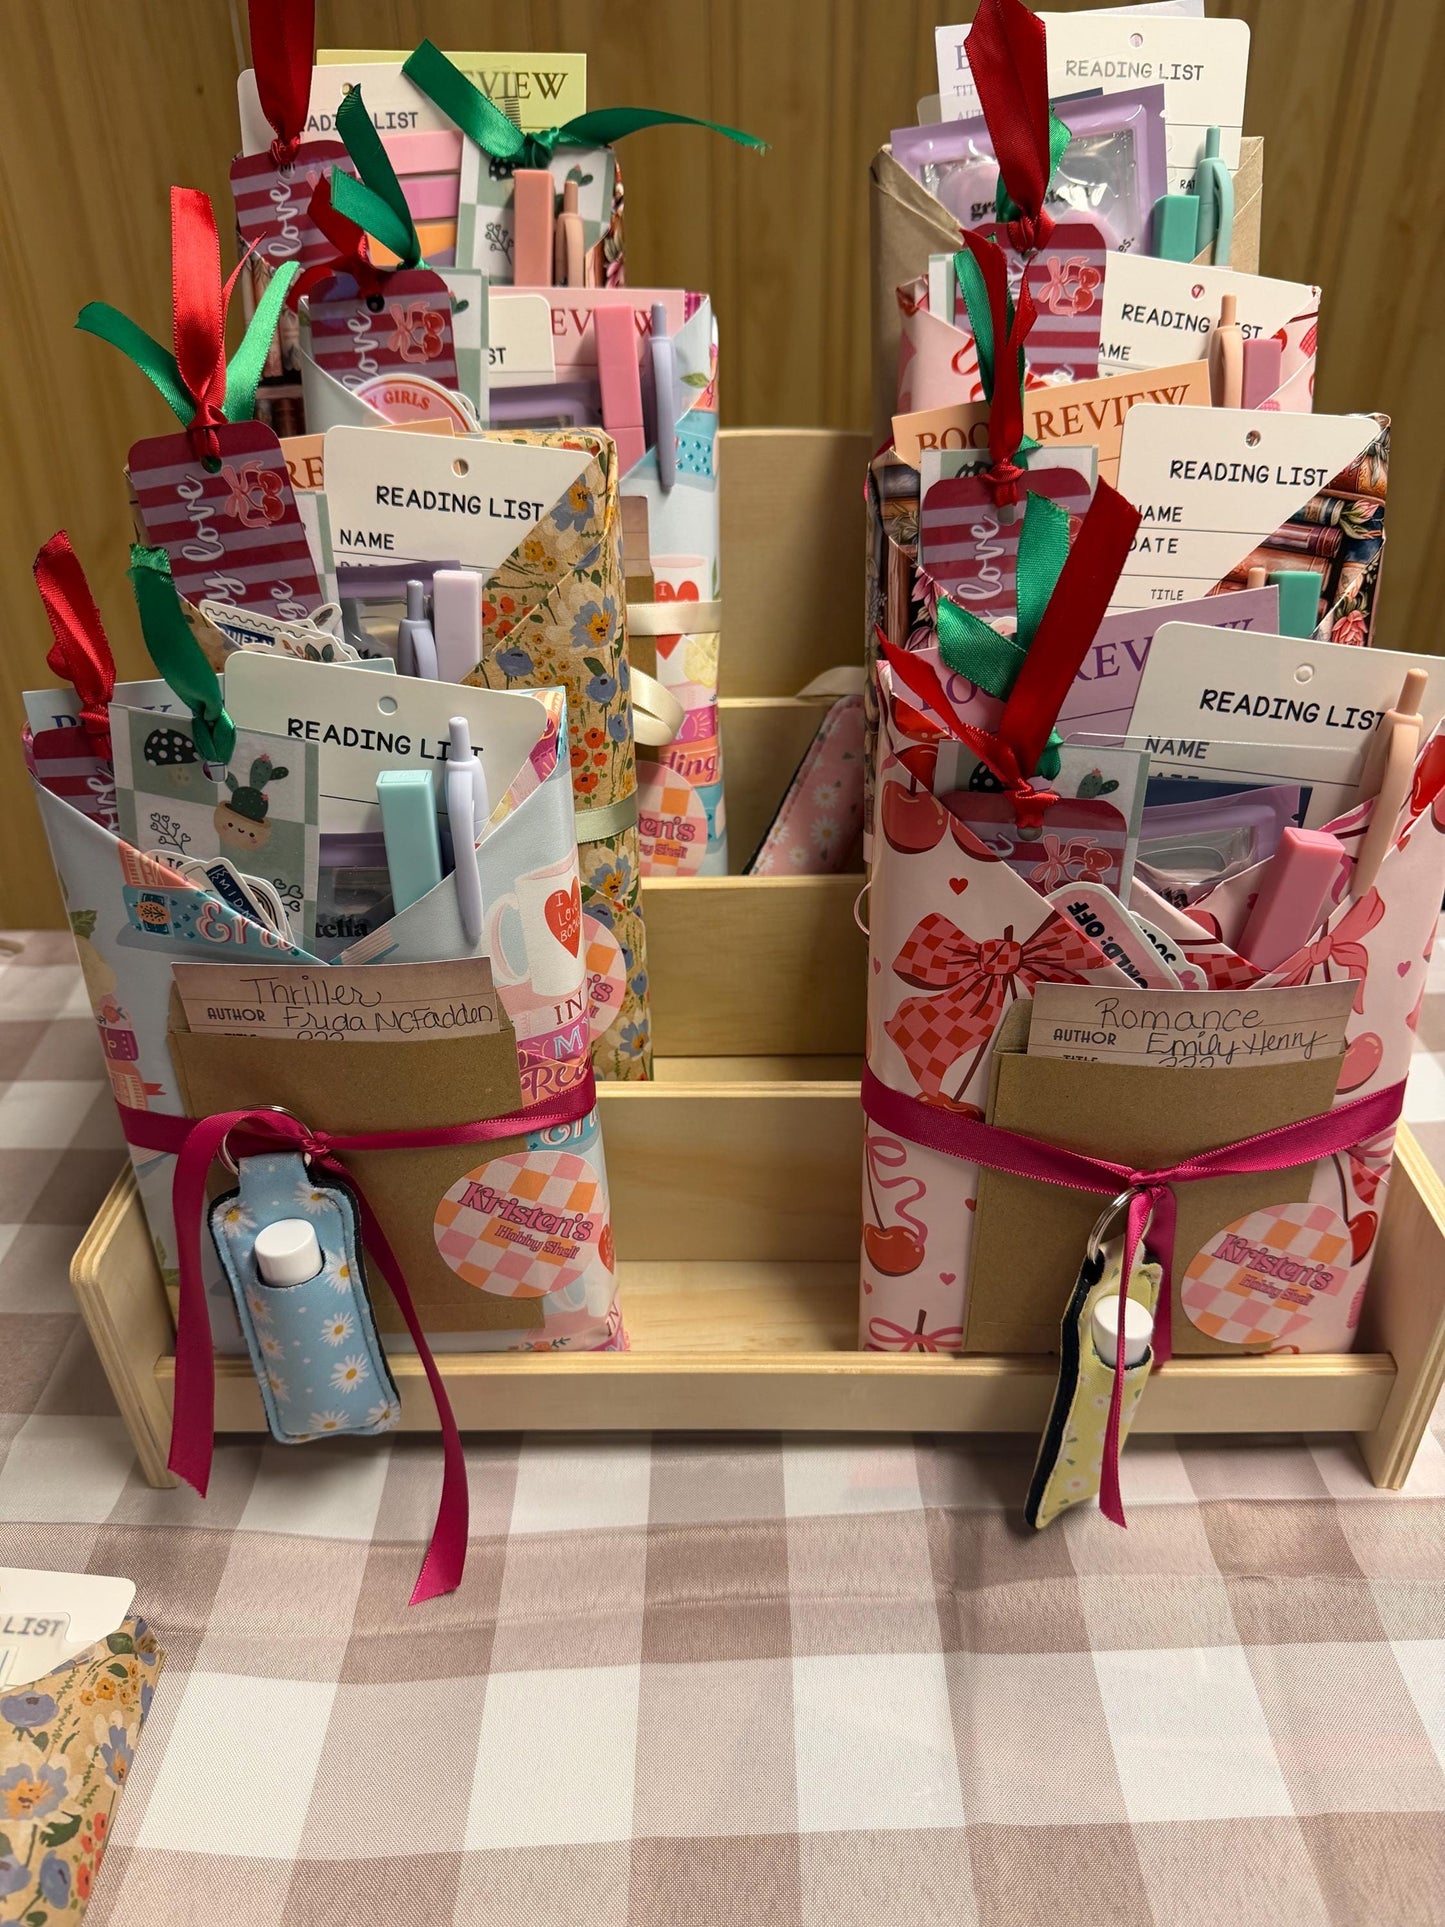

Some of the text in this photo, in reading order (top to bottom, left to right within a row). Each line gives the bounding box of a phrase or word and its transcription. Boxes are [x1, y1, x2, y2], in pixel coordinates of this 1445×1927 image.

[1065, 58, 1205, 81] READING LIST
[374, 111, 419, 130] LIST
[267, 179, 302, 257] love
[1121, 303, 1211, 334] READING
[1098, 342, 1132, 361] AME
[383, 390, 431, 411] GIRLS
[1169, 459, 1329, 487] READING LIST
[176, 474, 225, 562] love
[376, 485, 545, 522] READING LIST
[339, 528, 395, 551] NAME
[956, 515, 1005, 600] love
[1150, 588, 1184, 601] TITLE
[1199, 689, 1320, 724] READING
[287, 717, 412, 755] READING
[1144, 734, 1211, 761] NAME
[1067, 901, 1105, 938] OFF
[239, 974, 382, 1008] Thriller
[206, 1006, 267, 1023] AUTHOR
[1094, 996, 1264, 1033] Romance
[1052, 1027, 1118, 1046] AUTHOR
[1145, 1028, 1329, 1066] Emily Henry
[457, 1181, 594, 1242] Kristen's
[1211, 1232, 1335, 1291] Kristen's
[2, 1615, 65, 1638] LIST
